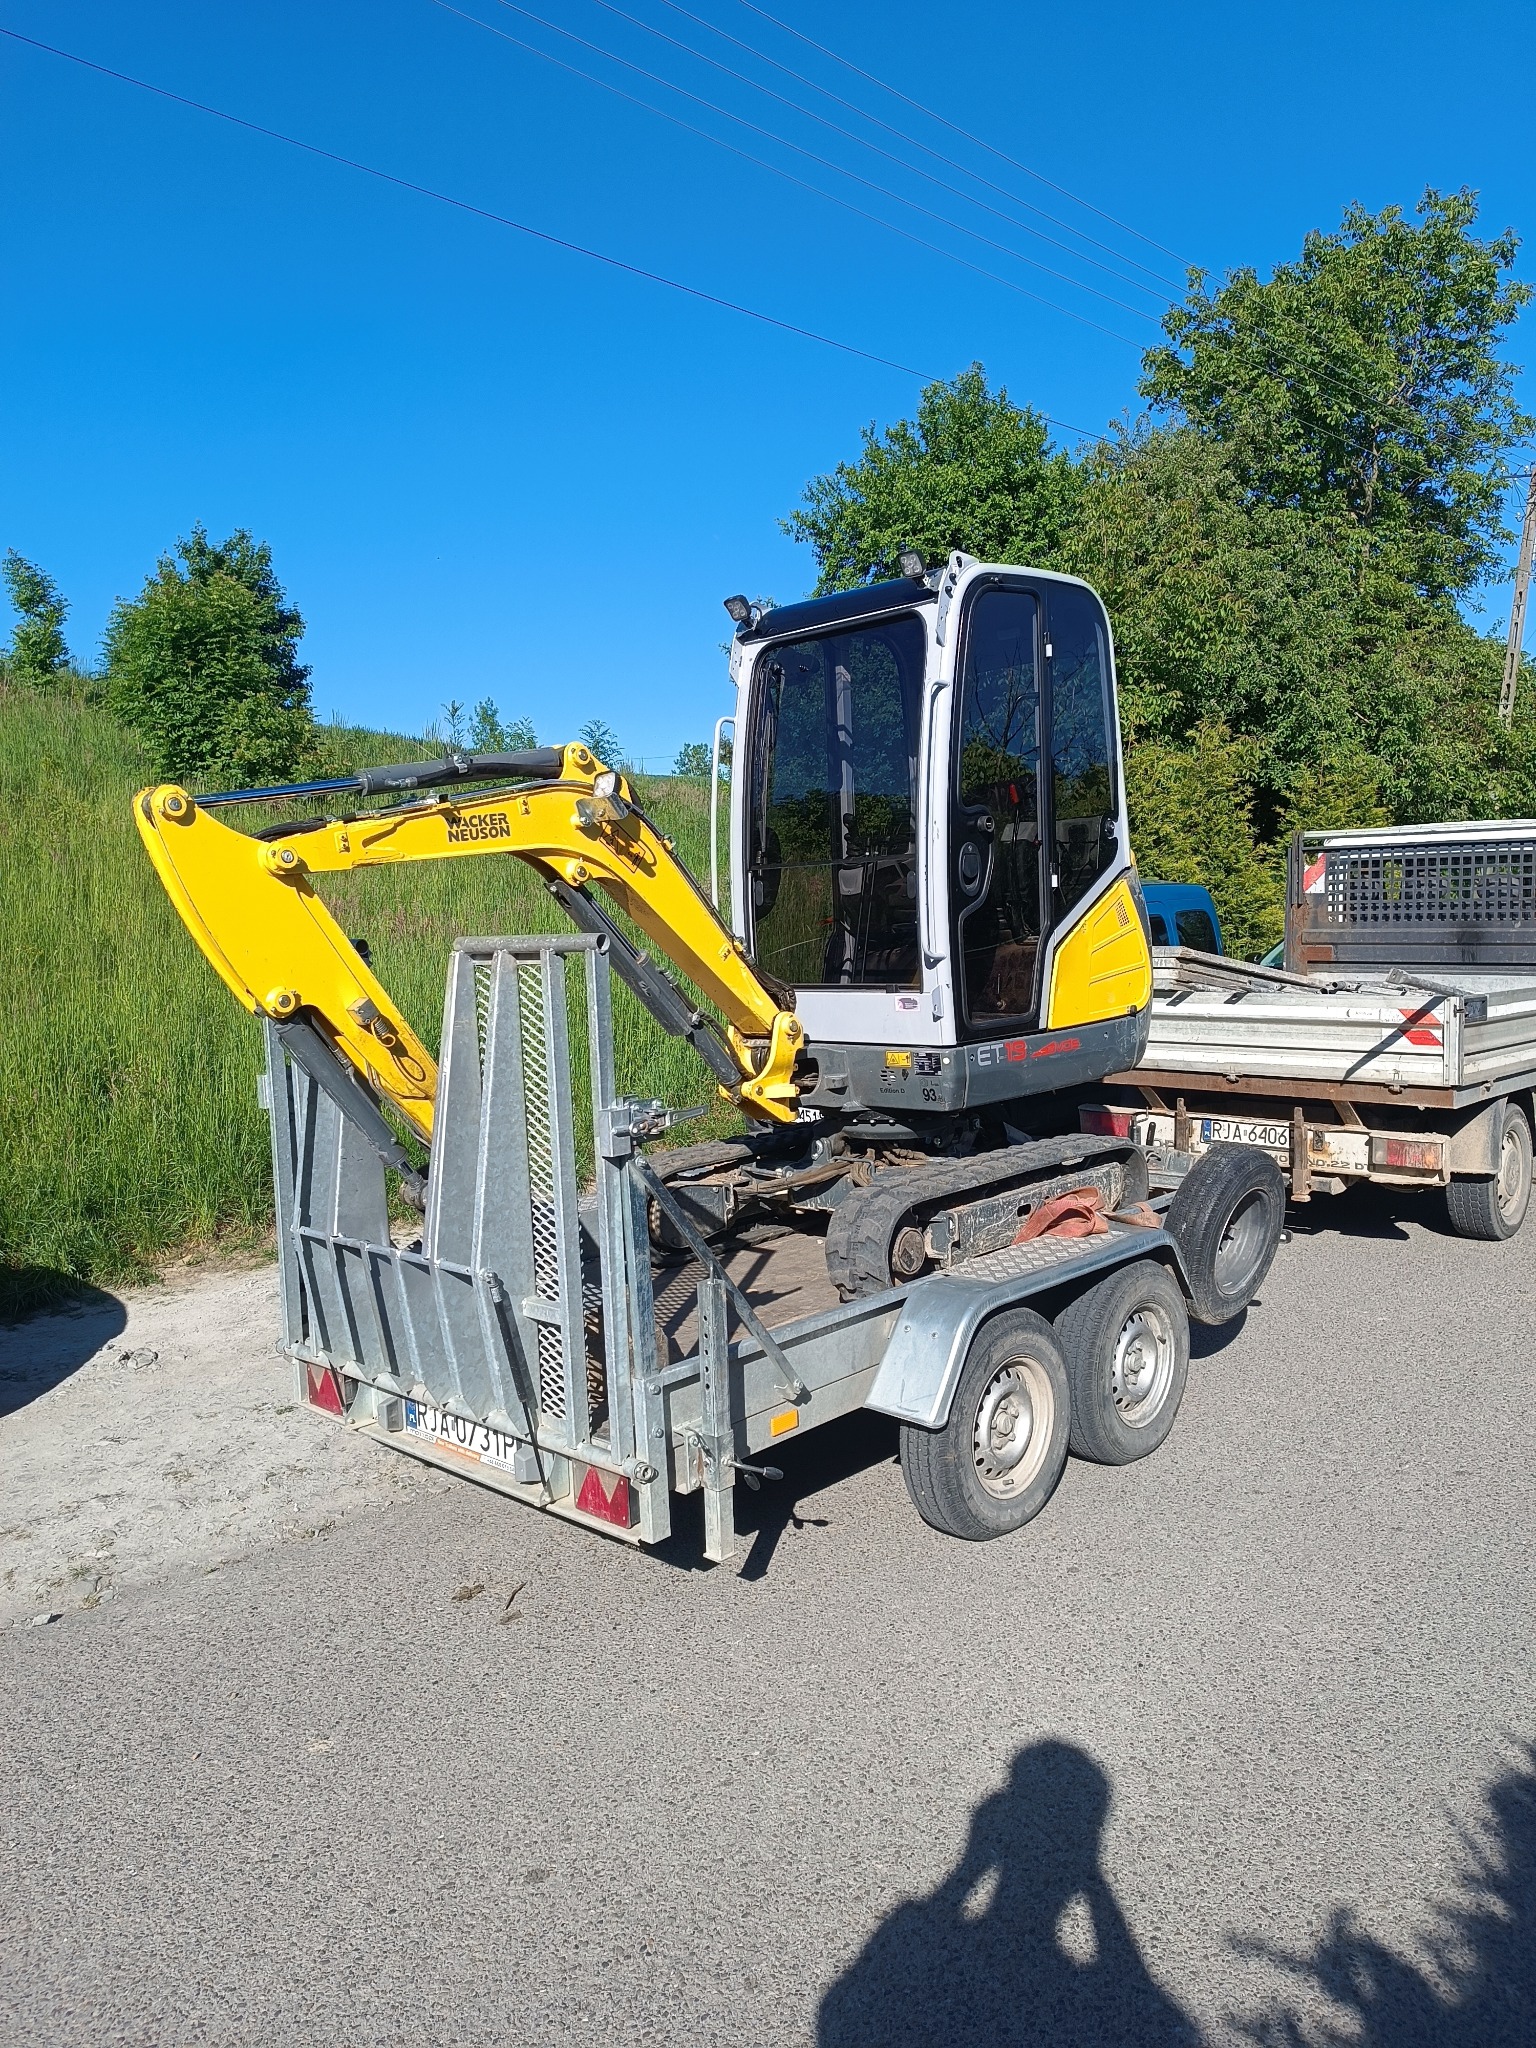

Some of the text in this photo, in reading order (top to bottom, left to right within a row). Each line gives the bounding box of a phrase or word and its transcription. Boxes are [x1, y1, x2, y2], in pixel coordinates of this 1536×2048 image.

[446, 813, 509, 829] WACKER
[448, 825, 511, 842] NEUSON
[977, 1040, 1027, 1067] ET19
[922, 1088, 937, 1101] 93
[1212, 1122, 1287, 1146] RJA 6406
[417, 1401, 451, 1439] RJA
